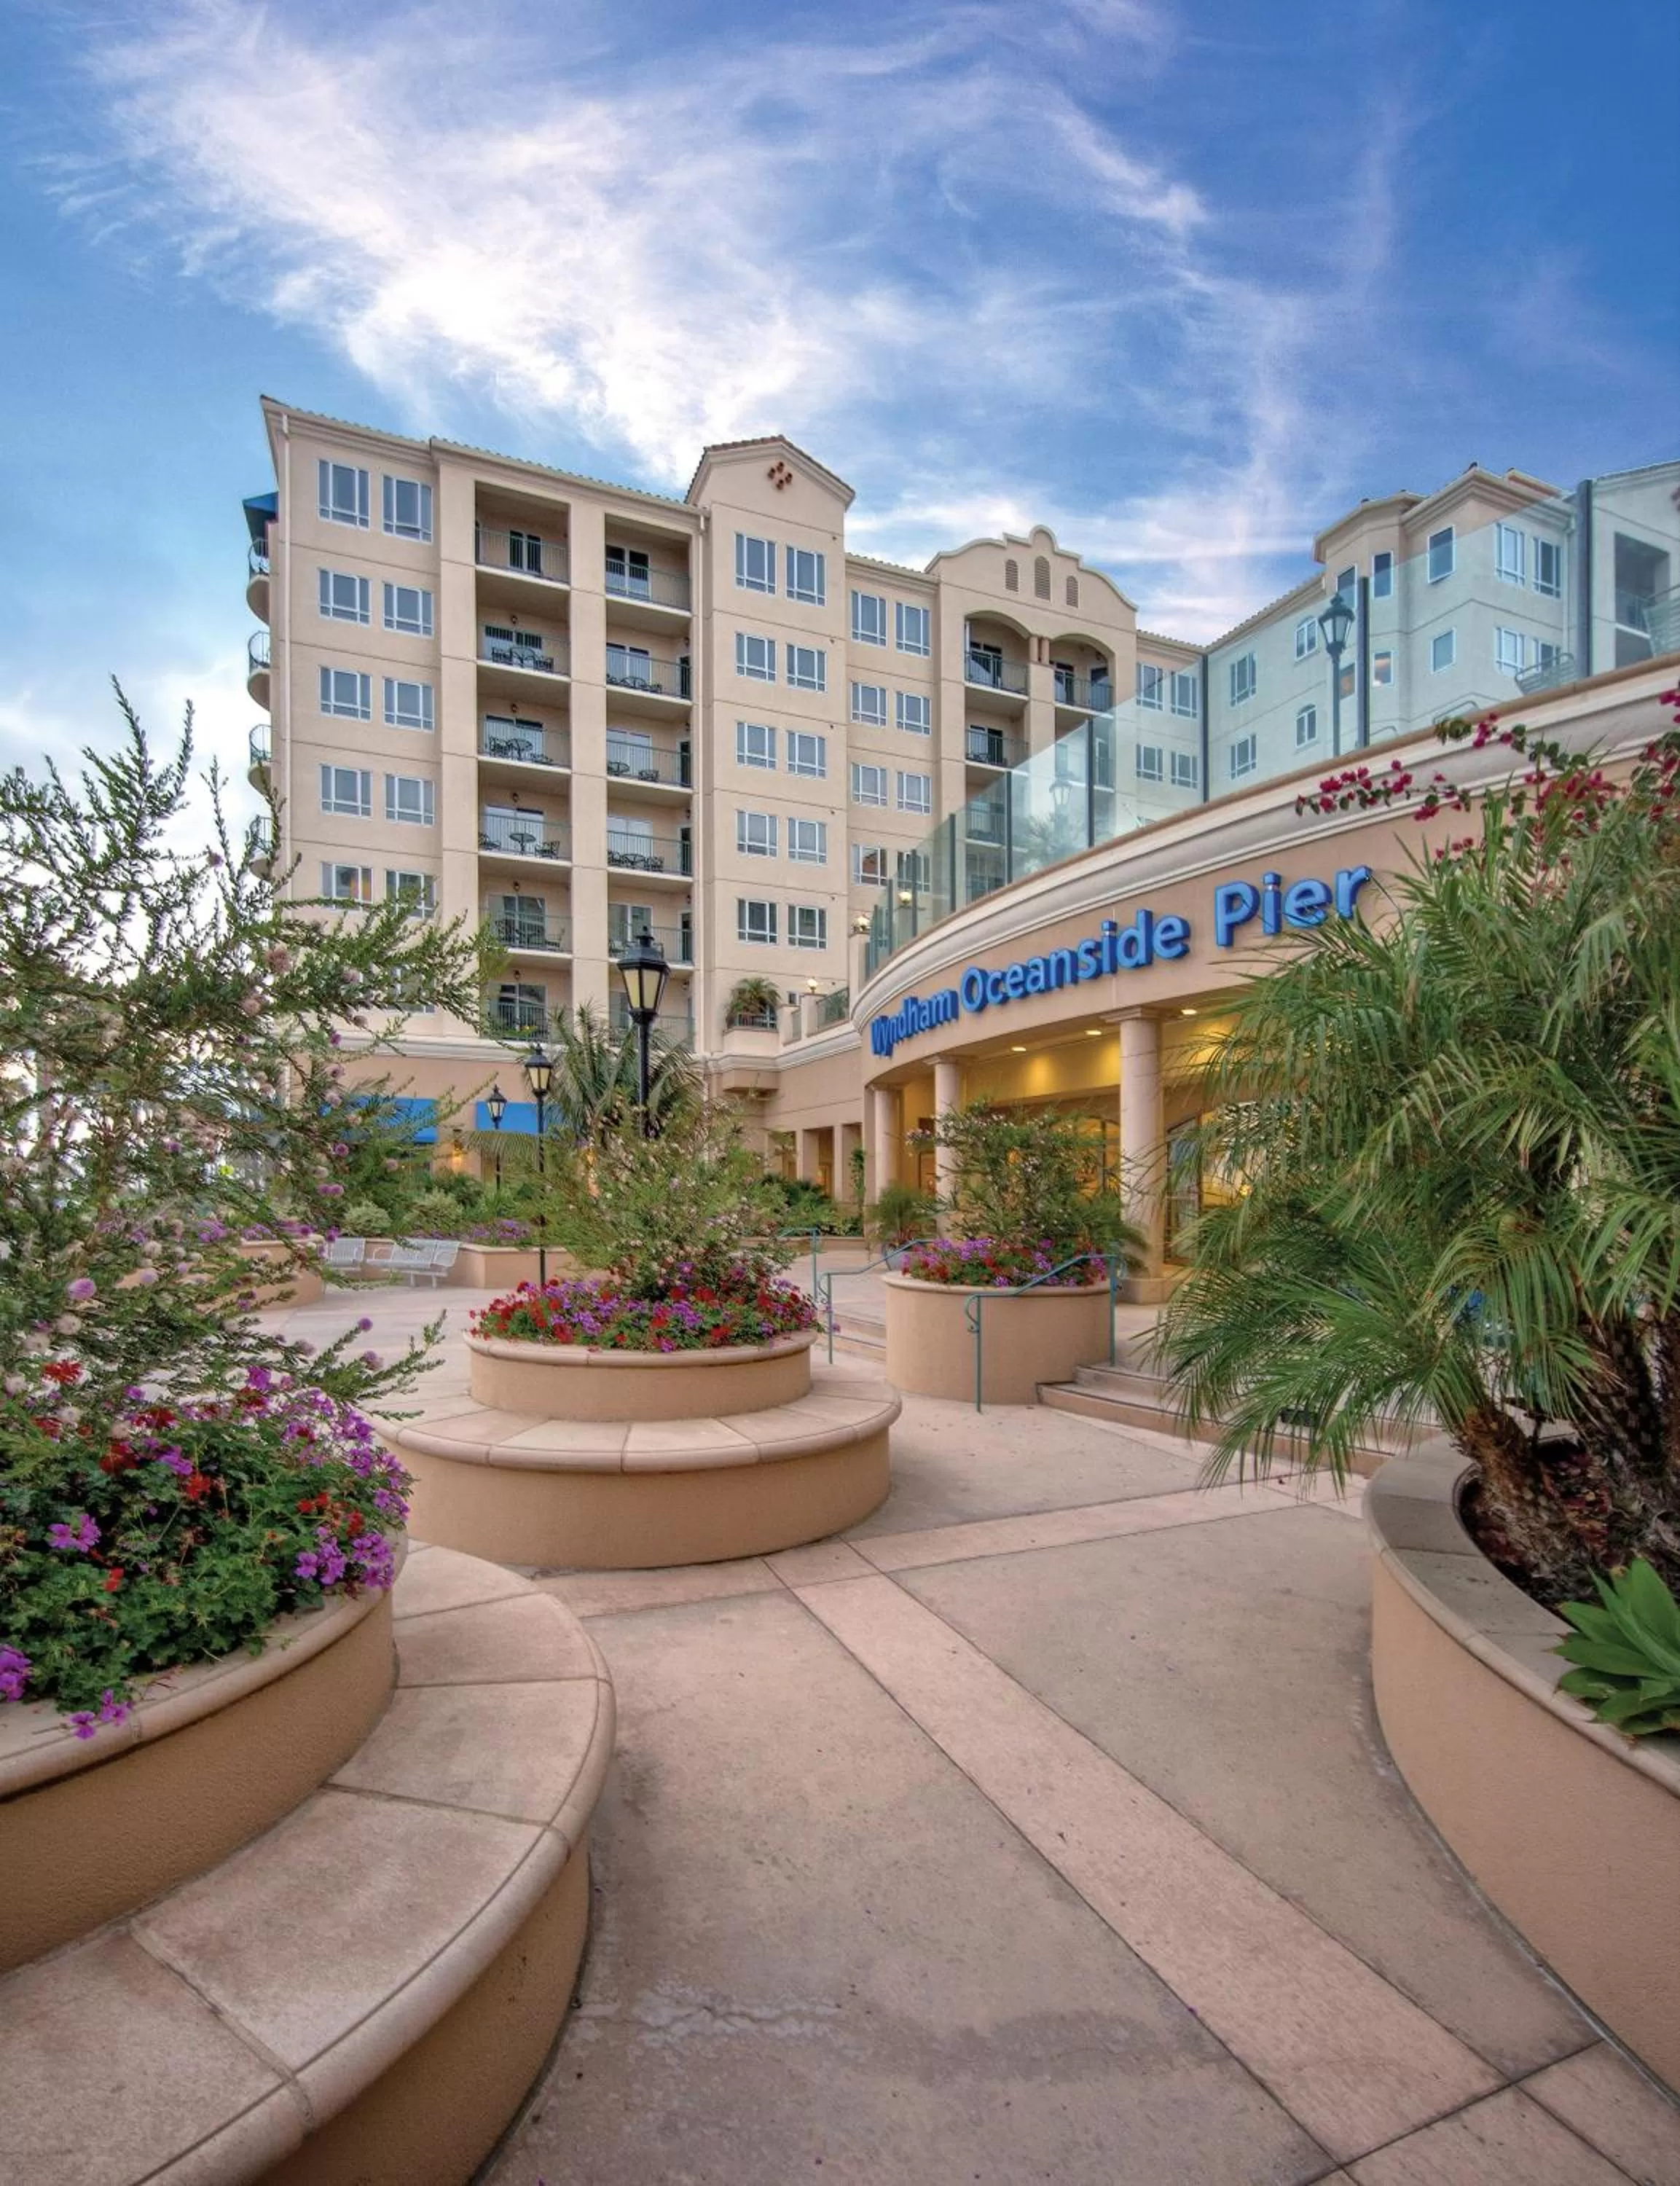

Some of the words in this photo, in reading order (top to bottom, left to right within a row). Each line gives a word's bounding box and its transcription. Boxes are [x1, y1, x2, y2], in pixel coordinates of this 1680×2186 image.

[872, 990, 959, 1056] Wyndham
[961, 909, 1190, 1012] Oceanside
[1215, 864, 1371, 947] Pier
